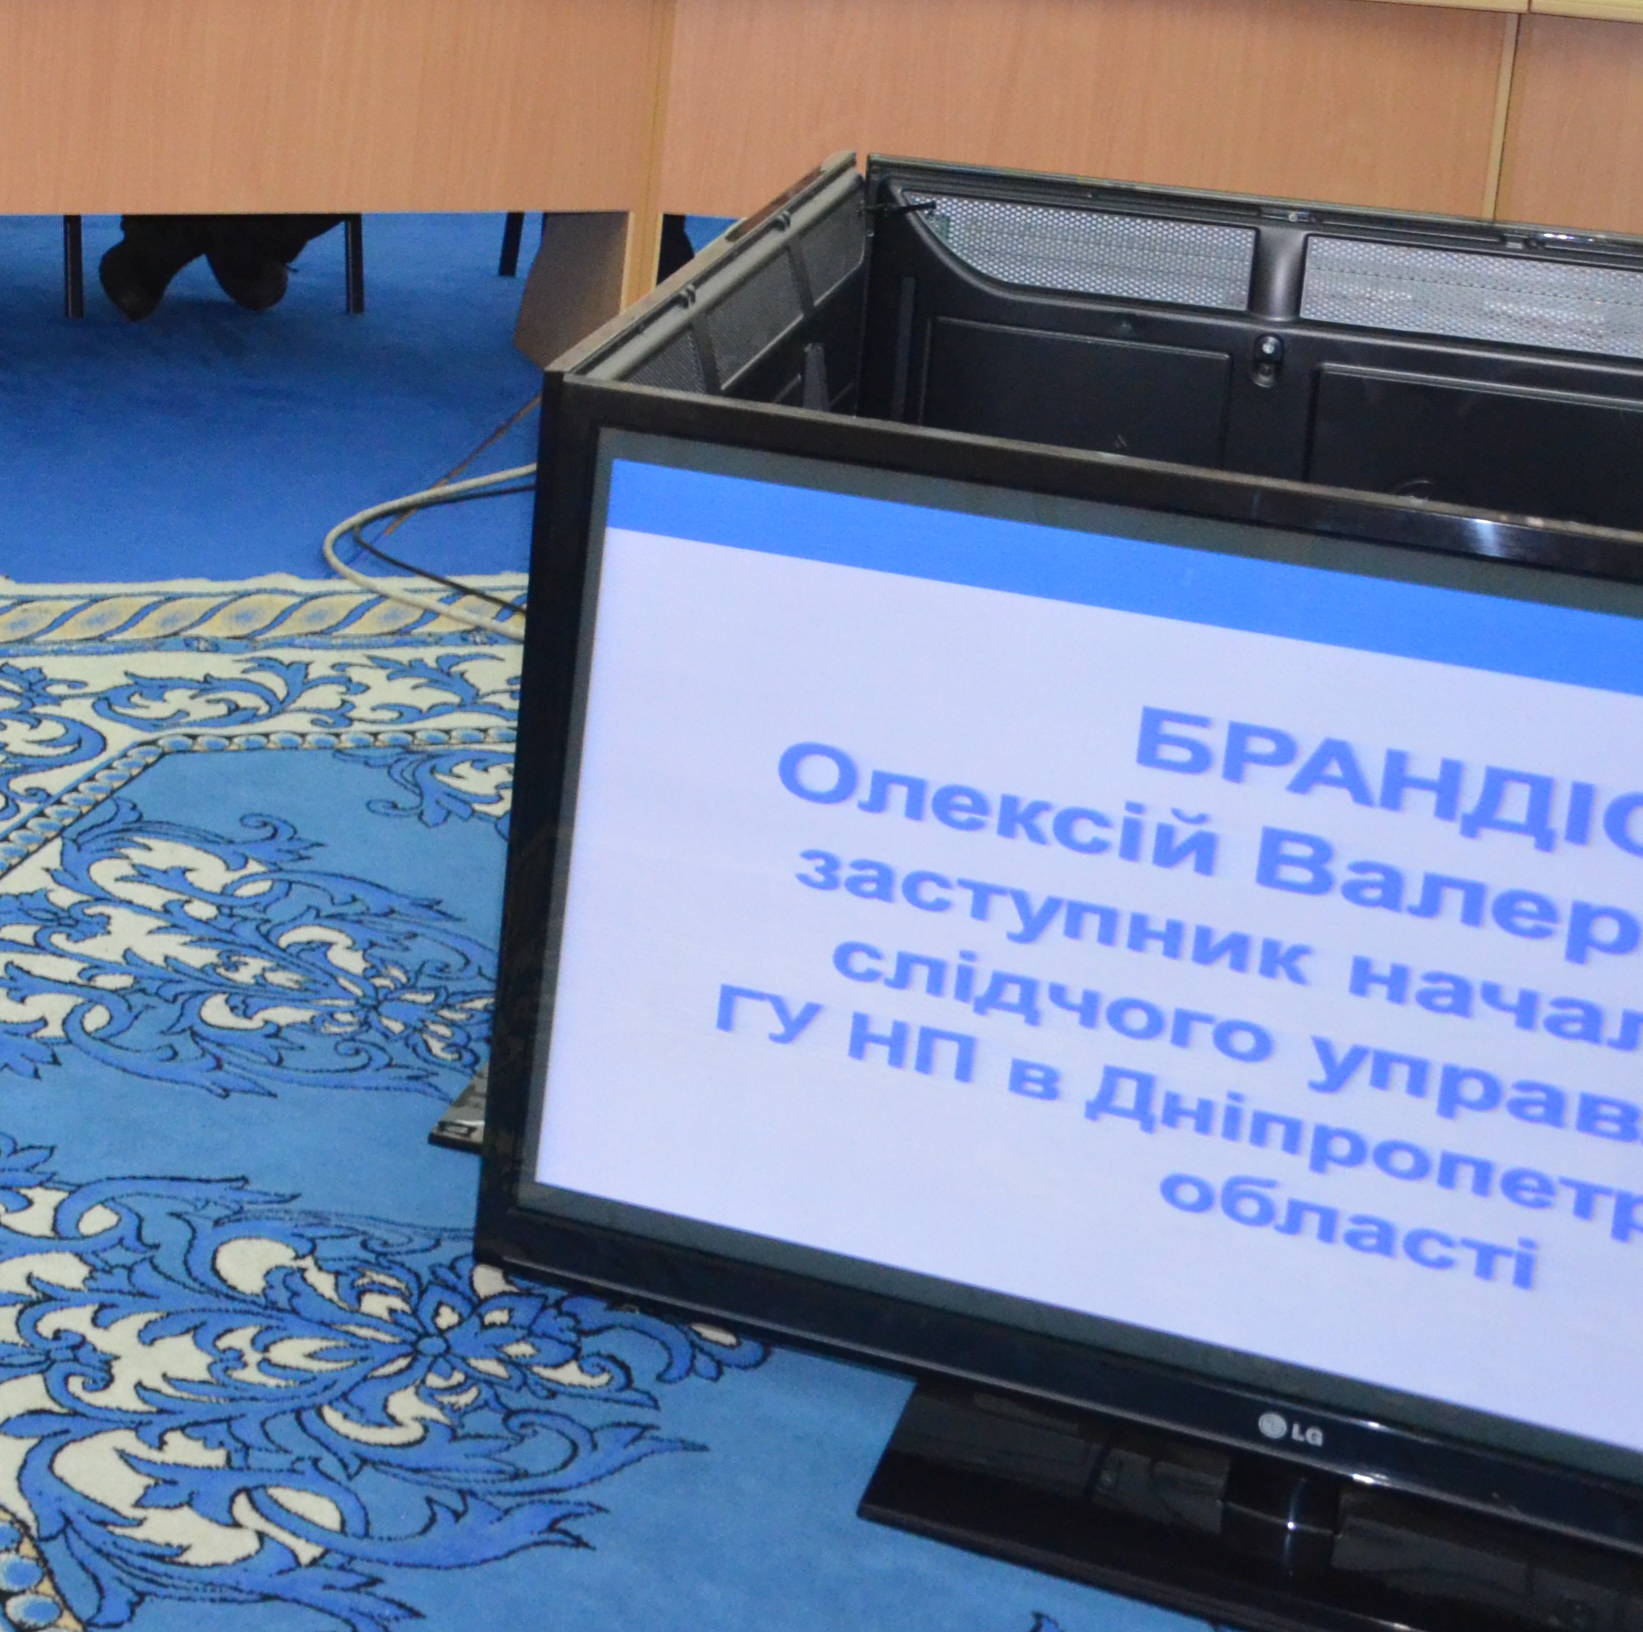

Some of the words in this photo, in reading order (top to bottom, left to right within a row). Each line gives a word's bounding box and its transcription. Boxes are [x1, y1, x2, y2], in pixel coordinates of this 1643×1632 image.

[778, 741, 1219, 876] Олексій
[795, 849, 1314, 985] заступник
[716, 984, 822, 1044] ГУ
[848, 1011, 978, 1084] НП
[1008, 1058, 1061, 1101] в
[832, 941, 1274, 1063] слідчого
[1159, 1172, 1538, 1291] області
[1292, 1423, 1324, 1447] LG
